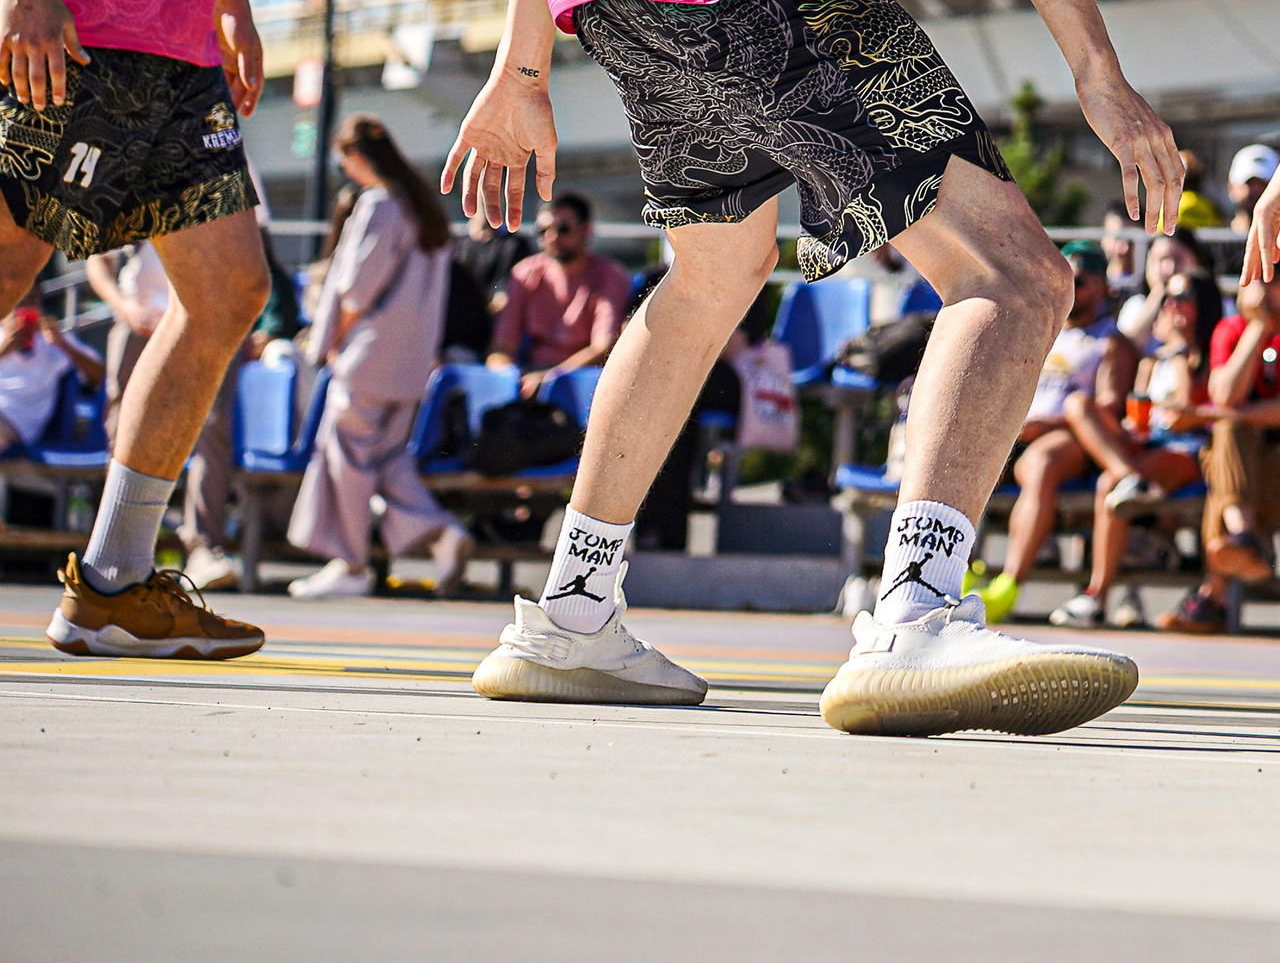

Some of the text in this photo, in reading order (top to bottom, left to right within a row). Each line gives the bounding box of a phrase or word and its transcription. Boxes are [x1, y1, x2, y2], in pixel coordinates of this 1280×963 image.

[520, 67, 540, 78] REC
[898, 517, 964, 544] JUMP
[568, 542, 615, 566] MAN
[899, 532, 954, 557] MAN
